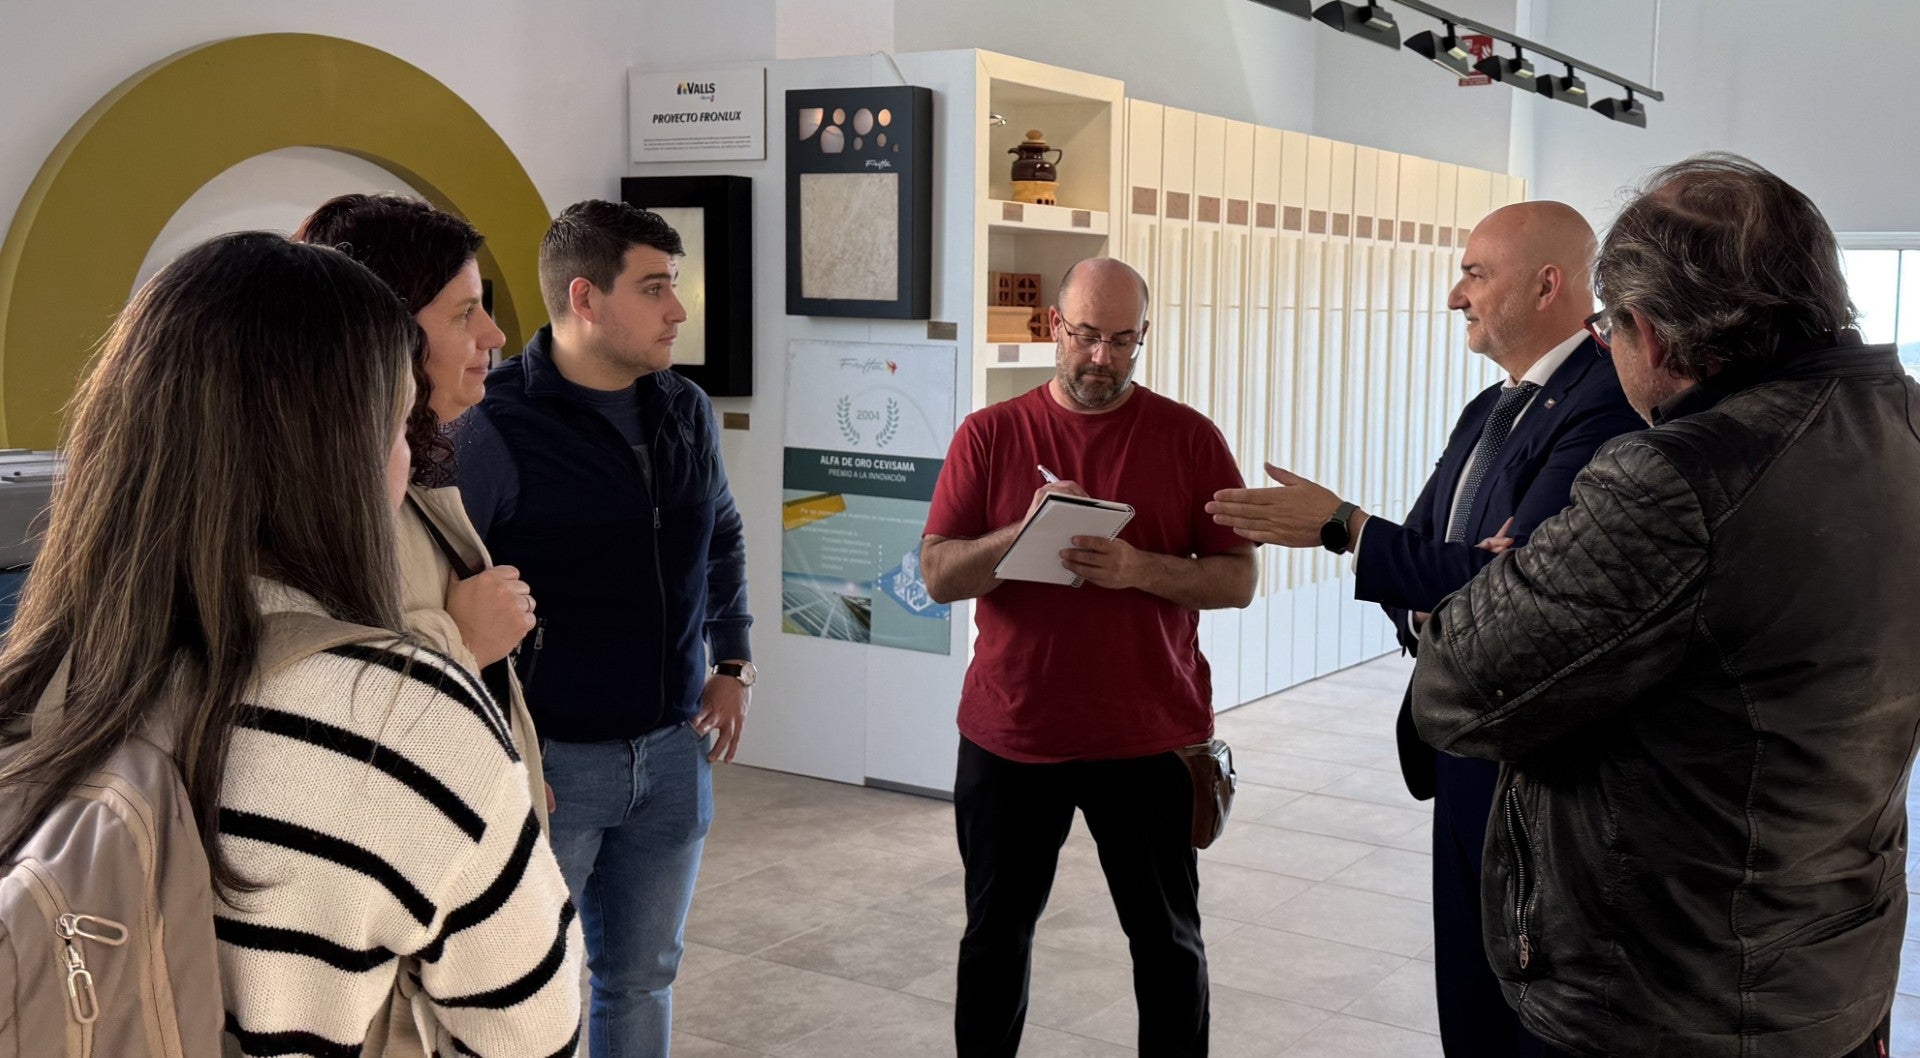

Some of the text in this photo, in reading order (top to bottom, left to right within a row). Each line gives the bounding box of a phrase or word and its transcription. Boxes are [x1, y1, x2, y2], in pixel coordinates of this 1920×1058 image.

[687, 82, 716, 94] VALLS
[652, 111, 742, 124] PROYECTO FRONLUX
[856, 409, 880, 421] 2004
[820, 455, 915, 472] ALFA DE ORO CEVISAMA
[828, 468, 906, 483] PREMIO A LA INNOVACIÓN
